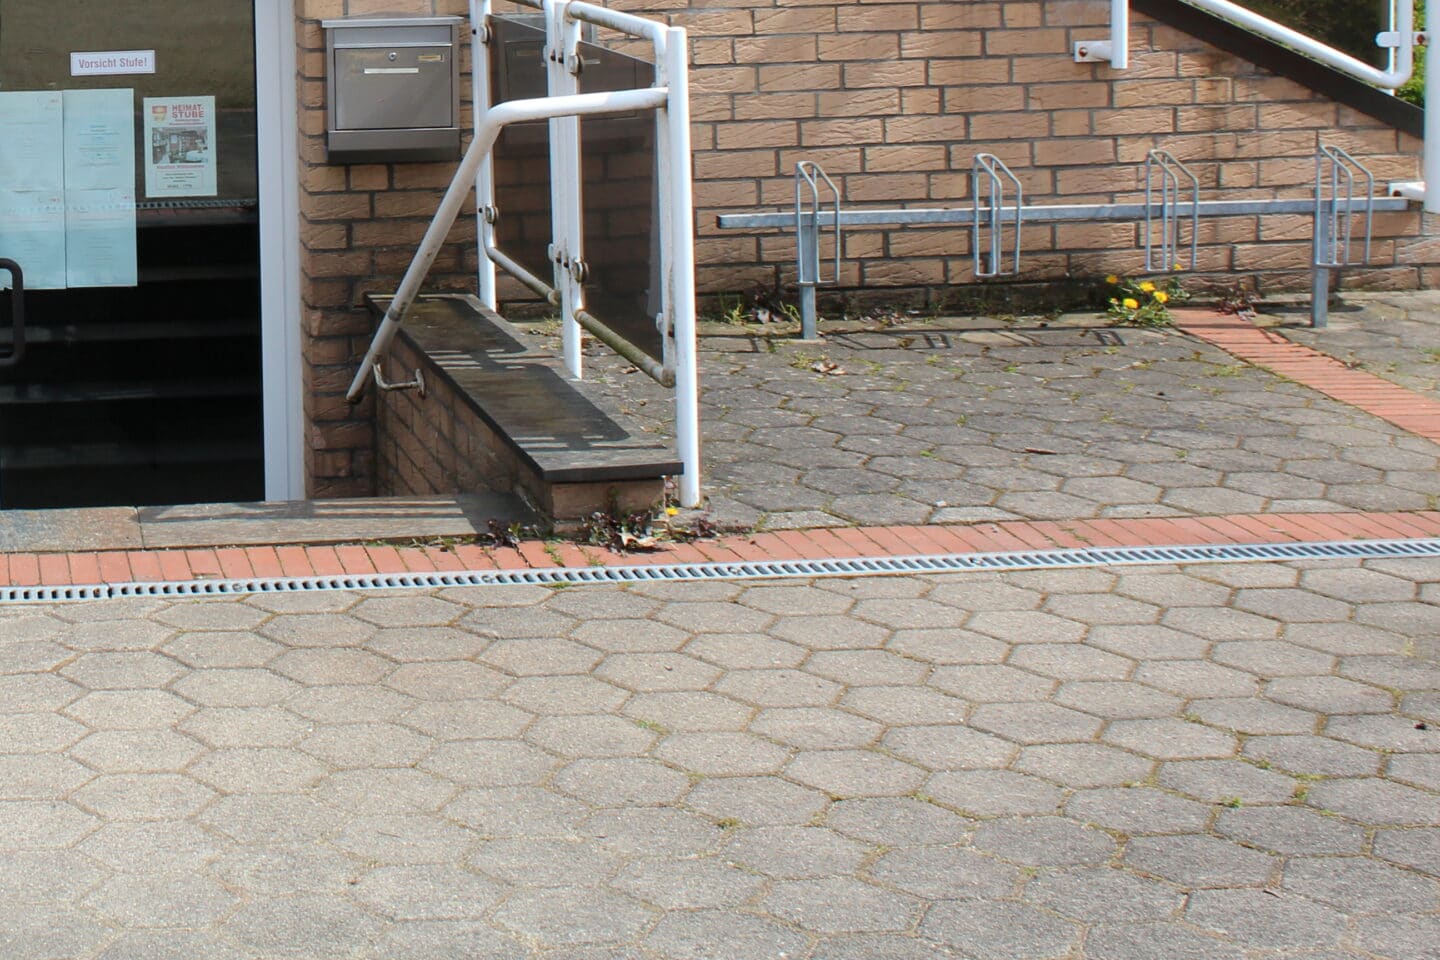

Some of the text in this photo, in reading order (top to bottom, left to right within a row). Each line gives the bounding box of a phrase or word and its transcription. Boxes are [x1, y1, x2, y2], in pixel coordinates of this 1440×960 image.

[78, 57, 148, 69] Vorsicht Stufe!
[172, 111, 205, 119] STUBE
